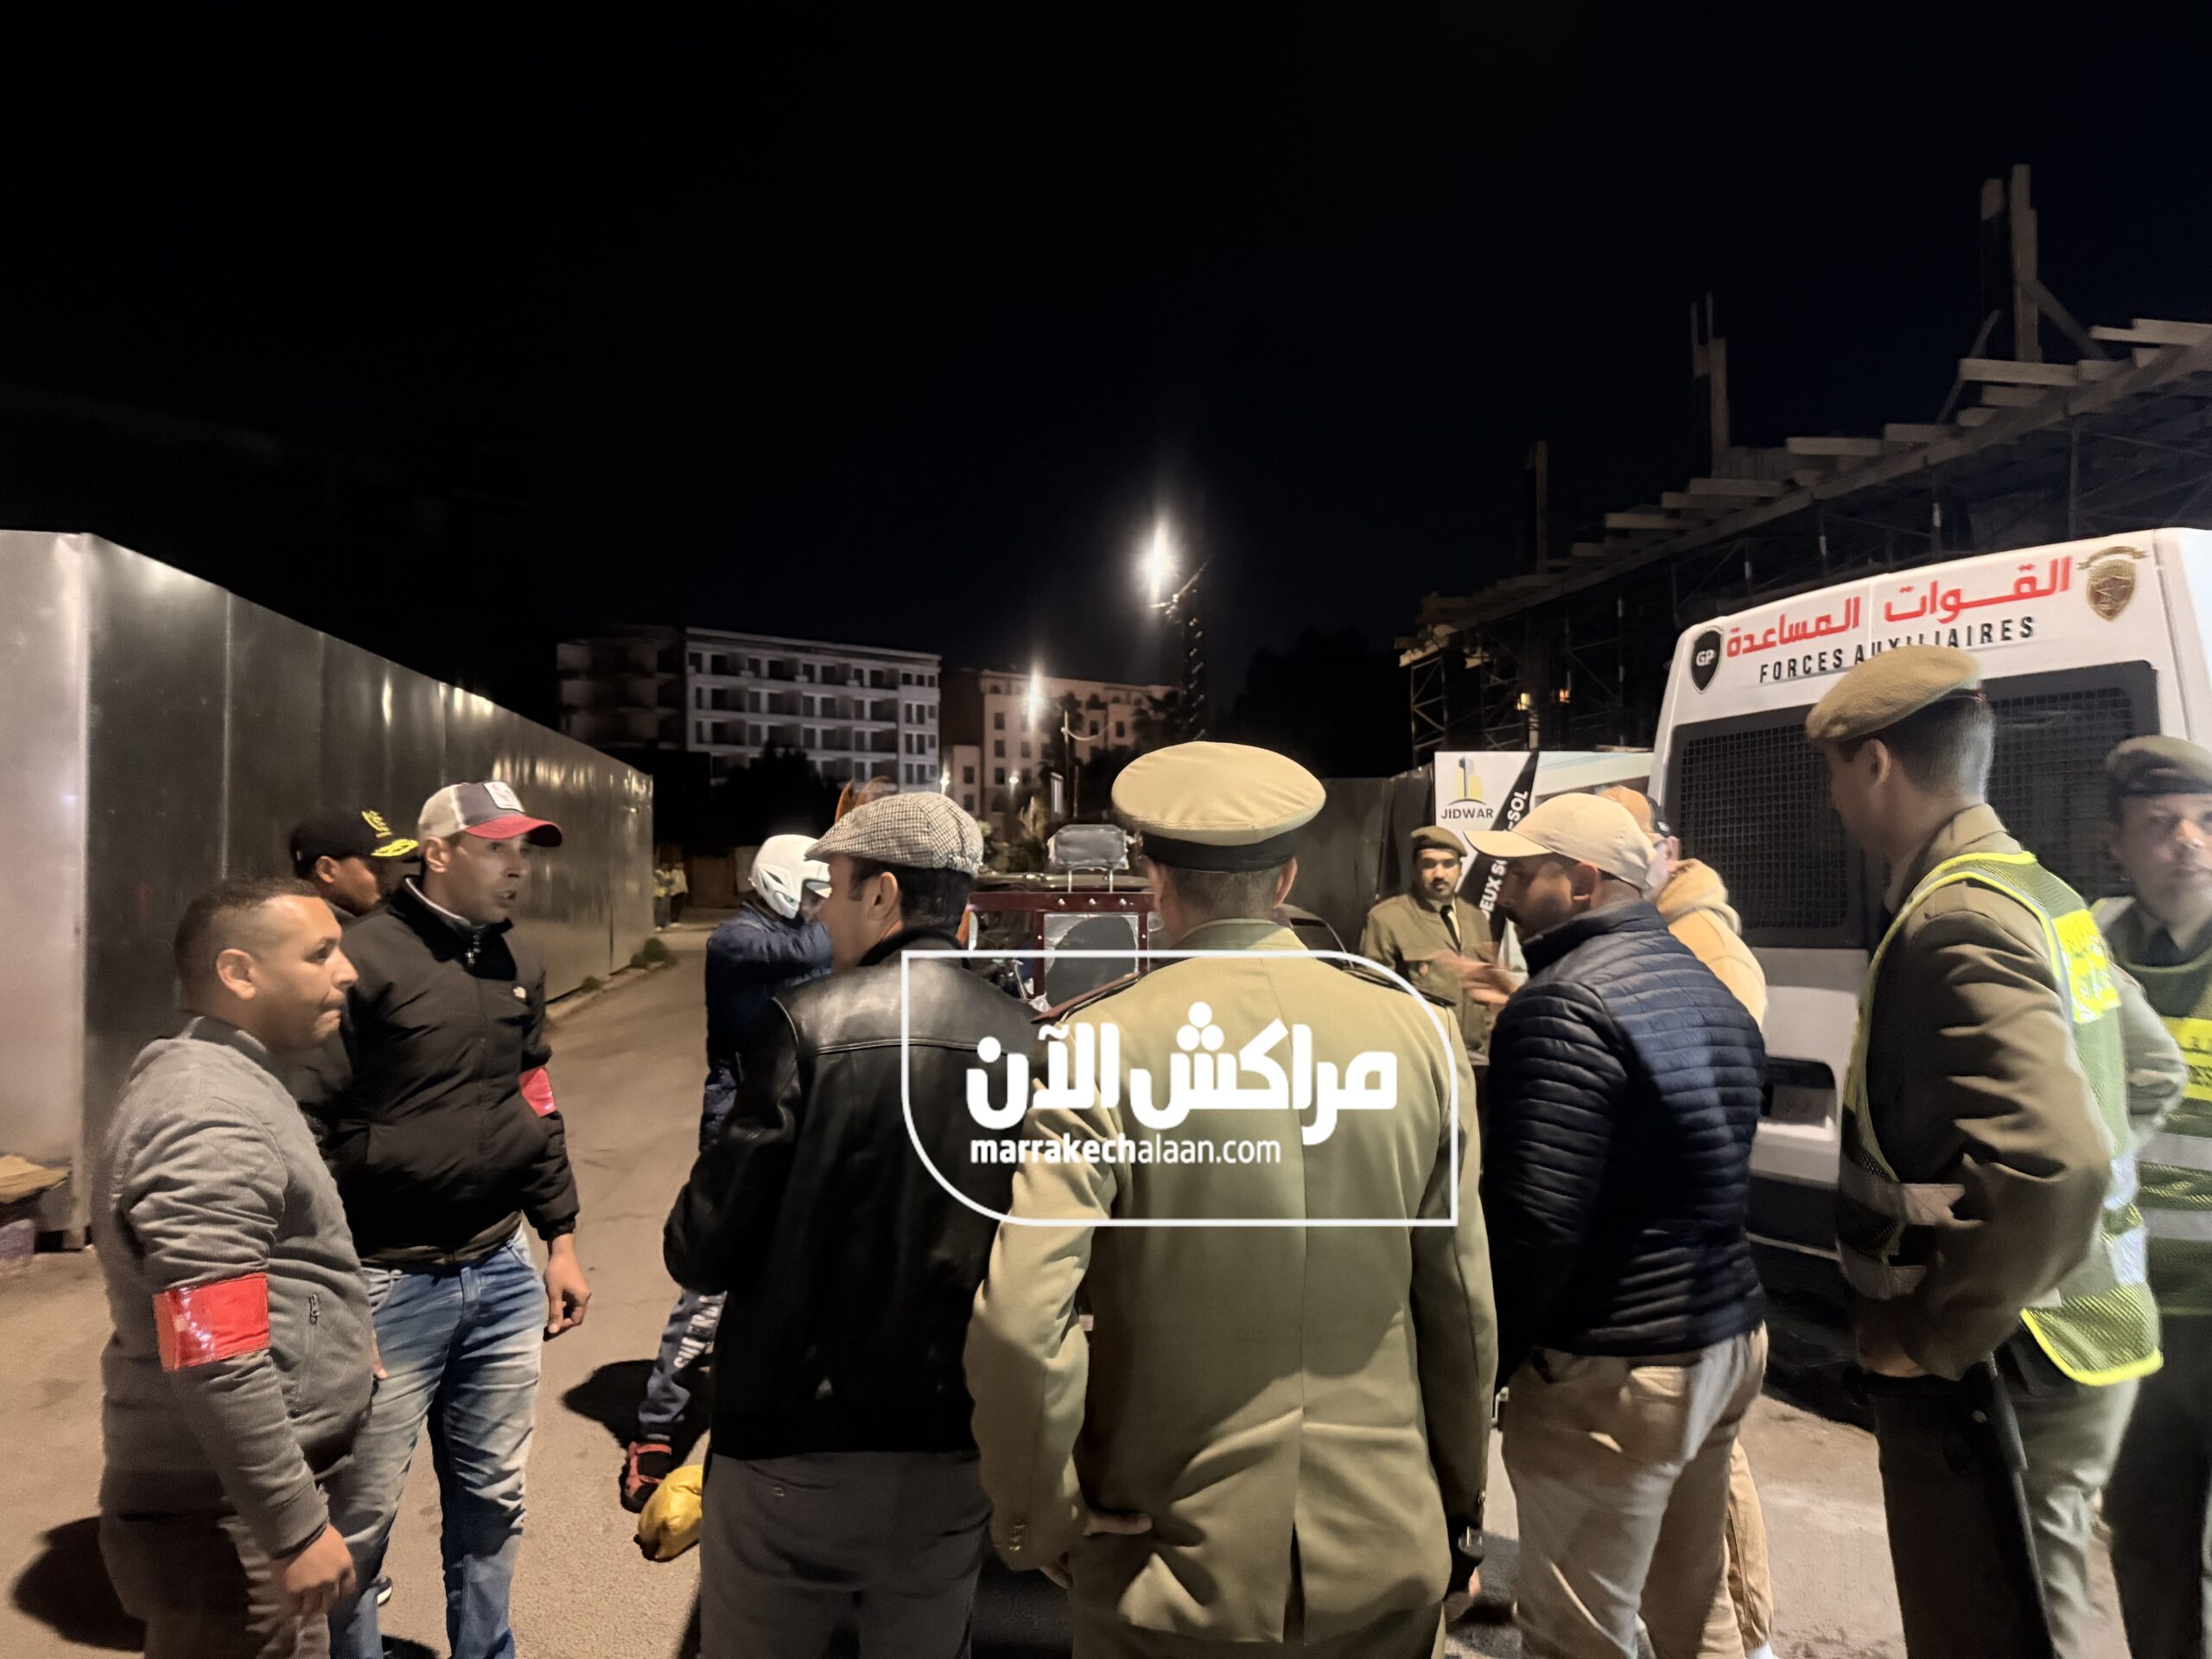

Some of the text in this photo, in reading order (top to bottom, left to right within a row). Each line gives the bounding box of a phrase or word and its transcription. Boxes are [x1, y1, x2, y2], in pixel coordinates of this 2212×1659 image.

[1726, 556, 2072, 658] القوات المساعدة
[1695, 649, 1715, 666] GP
[1760, 648, 1844, 683] FORCES
[1440, 808, 1494, 820] JIDWAR
